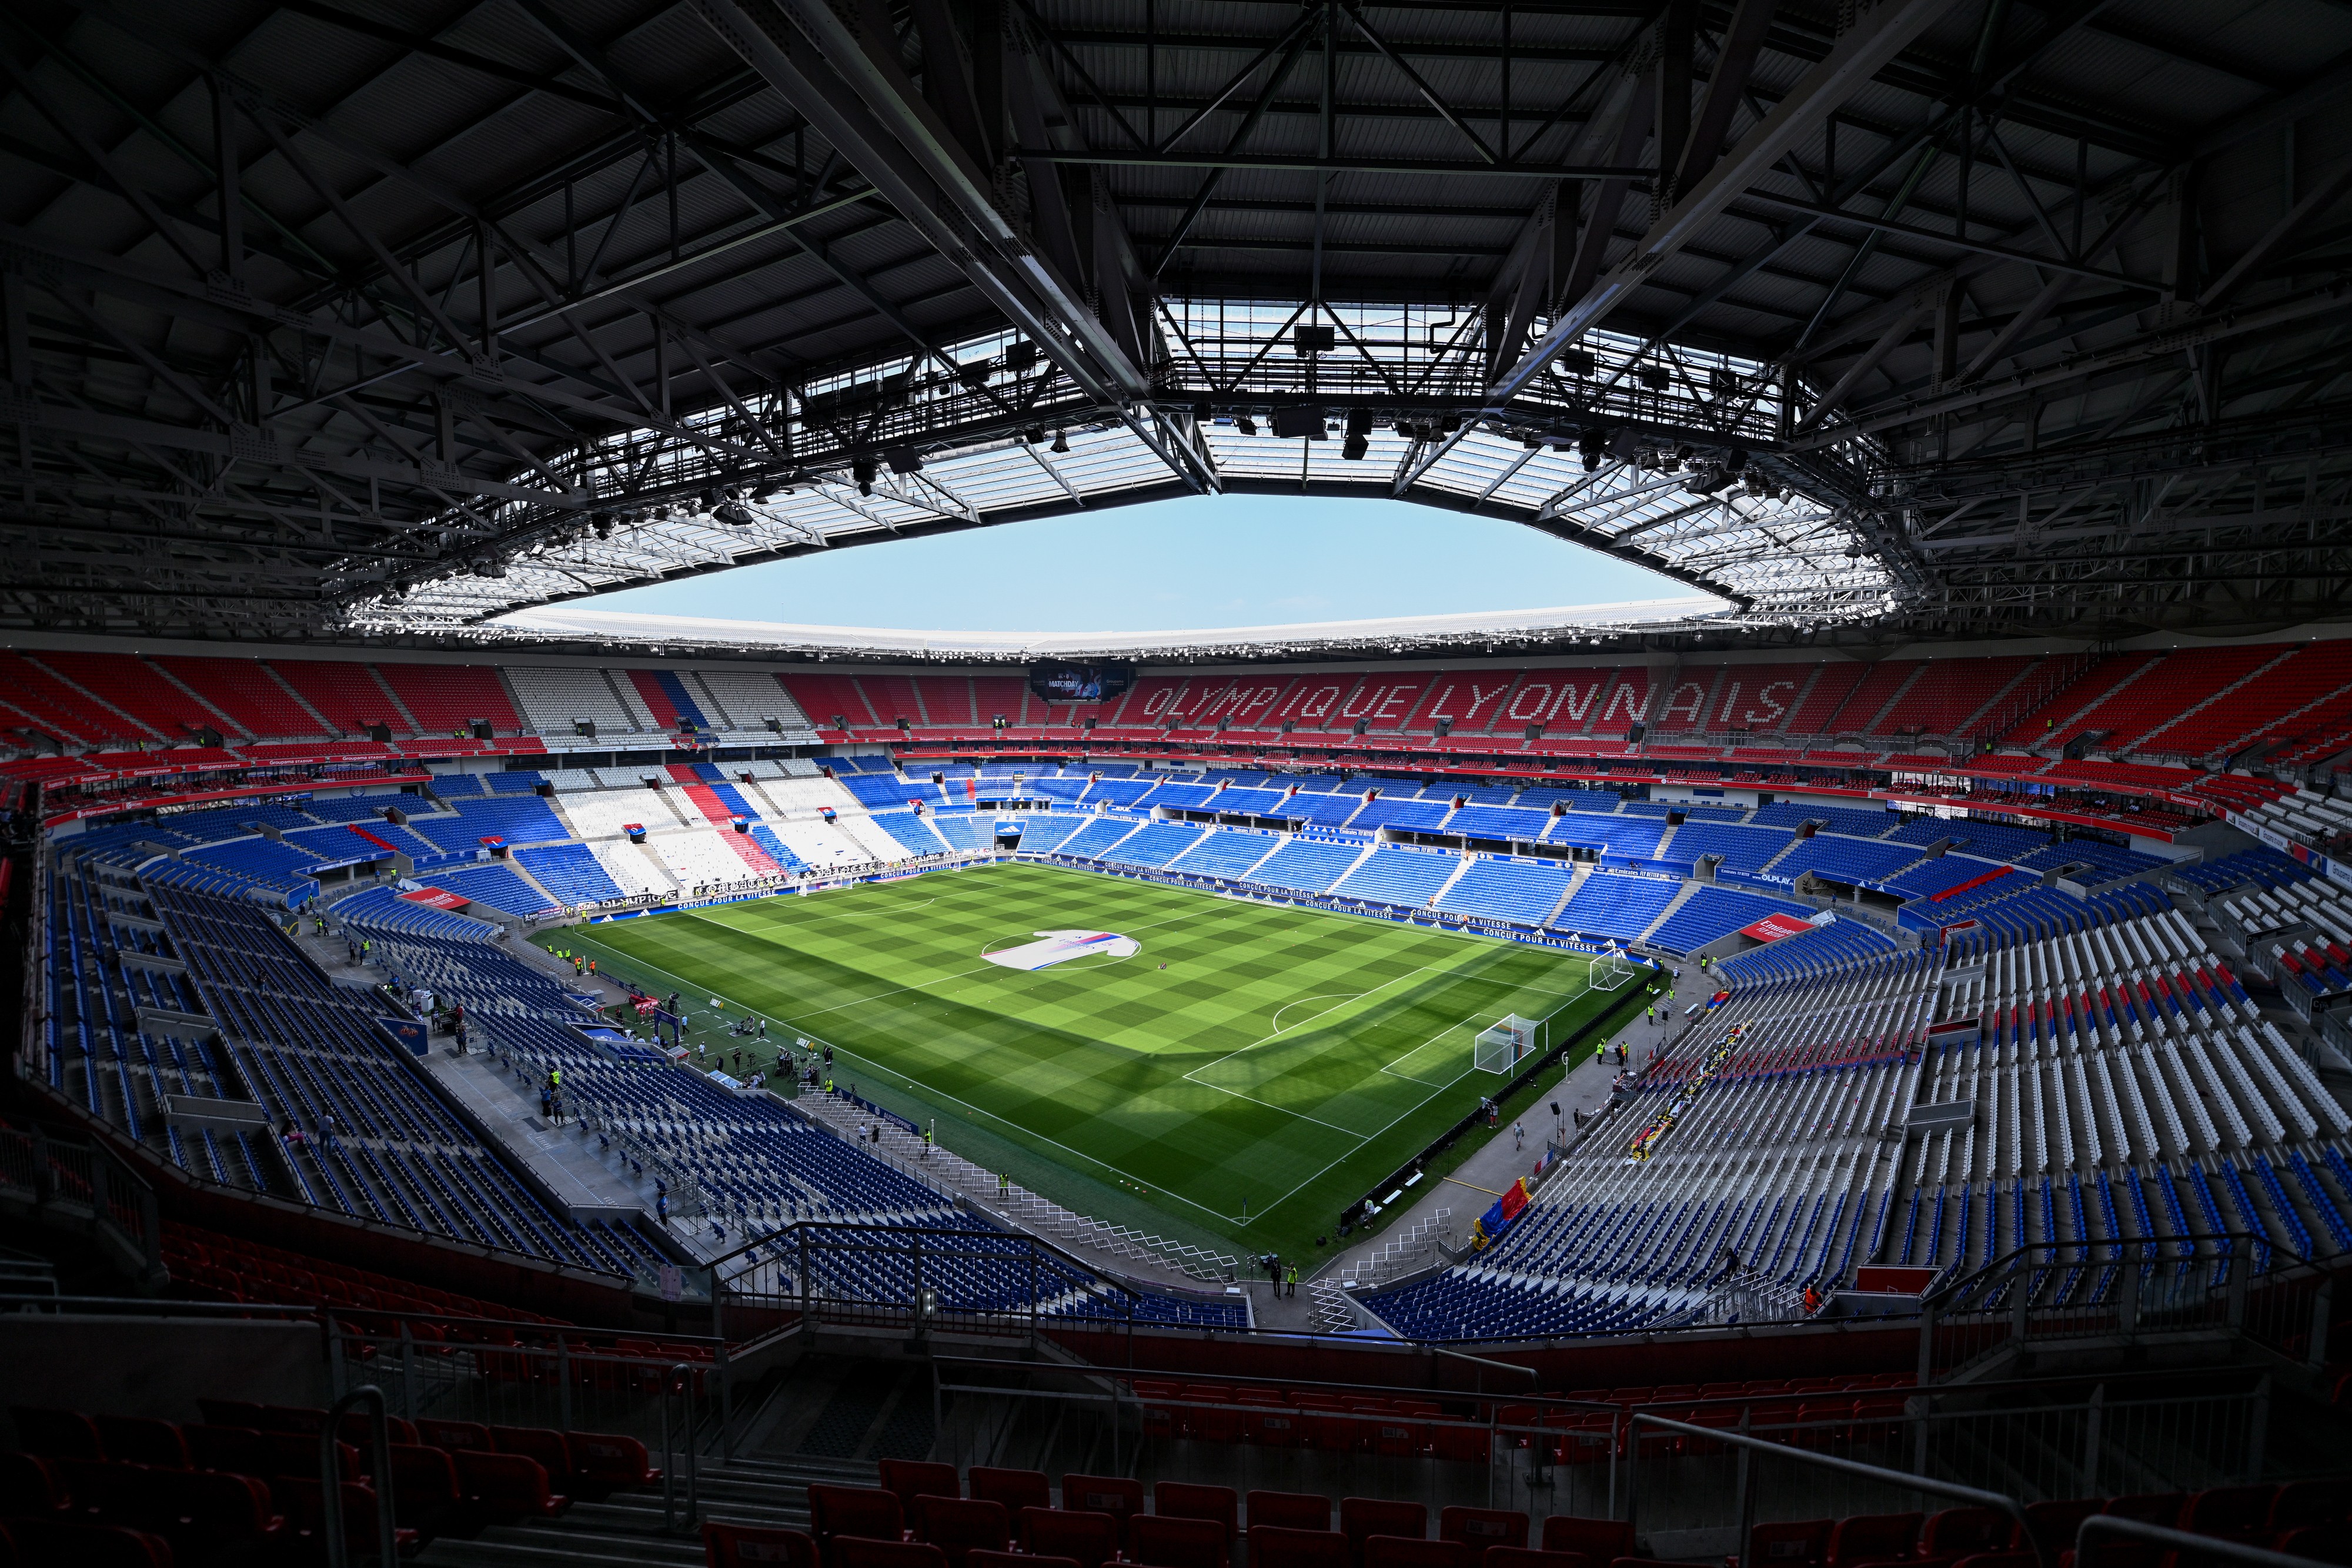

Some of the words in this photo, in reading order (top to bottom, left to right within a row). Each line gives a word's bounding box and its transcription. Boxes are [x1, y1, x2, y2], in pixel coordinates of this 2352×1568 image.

[1144, 686, 1417, 718] OLYMPIQUE
[1428, 682, 1794, 722] LYONNAIS
[2170, 794, 2186, 804] Groupama
[880, 870, 904, 879] CONÇUE
[931, 863, 952, 871] VITESSE
[1041, 858, 1058, 867] CONÇUE
[1077, 863, 1095, 872] VITESSE
[1105, 861, 1123, 871] COÇUE
[1144, 867, 1164, 876] VITESSE
[2332, 864, 2350, 882] Groupama
[1149, 875, 1169, 884] CONÇUE
[1194, 882, 1215, 891] VITESSE
[1239, 882, 1262, 892] CONÇUE
[1263, 885, 1279, 894] POUR
[1289, 890, 1314, 900] VITESSE
[421, 892, 451, 904] mirates
[677, 899, 710, 910] CONÇUE
[713, 896, 733, 904] POUR
[747, 890, 776, 899] VITESSE
[1305, 900, 1331, 910] CONÇUE
[1363, 909, 1392, 920] VITESSE
[1412, 908, 1442, 919] CONÇUE
[1479, 919, 1511, 930] VITESSE
[1760, 920, 1799, 935] Emirates
[1484, 928, 1517, 940] CONÇUE
[1520, 934, 1543, 944] POUR
[1546, 938, 1556, 947] LA
[1560, 940, 1597, 953] VITESSE
[883, 1112, 911, 1131] AUSHOPPING
